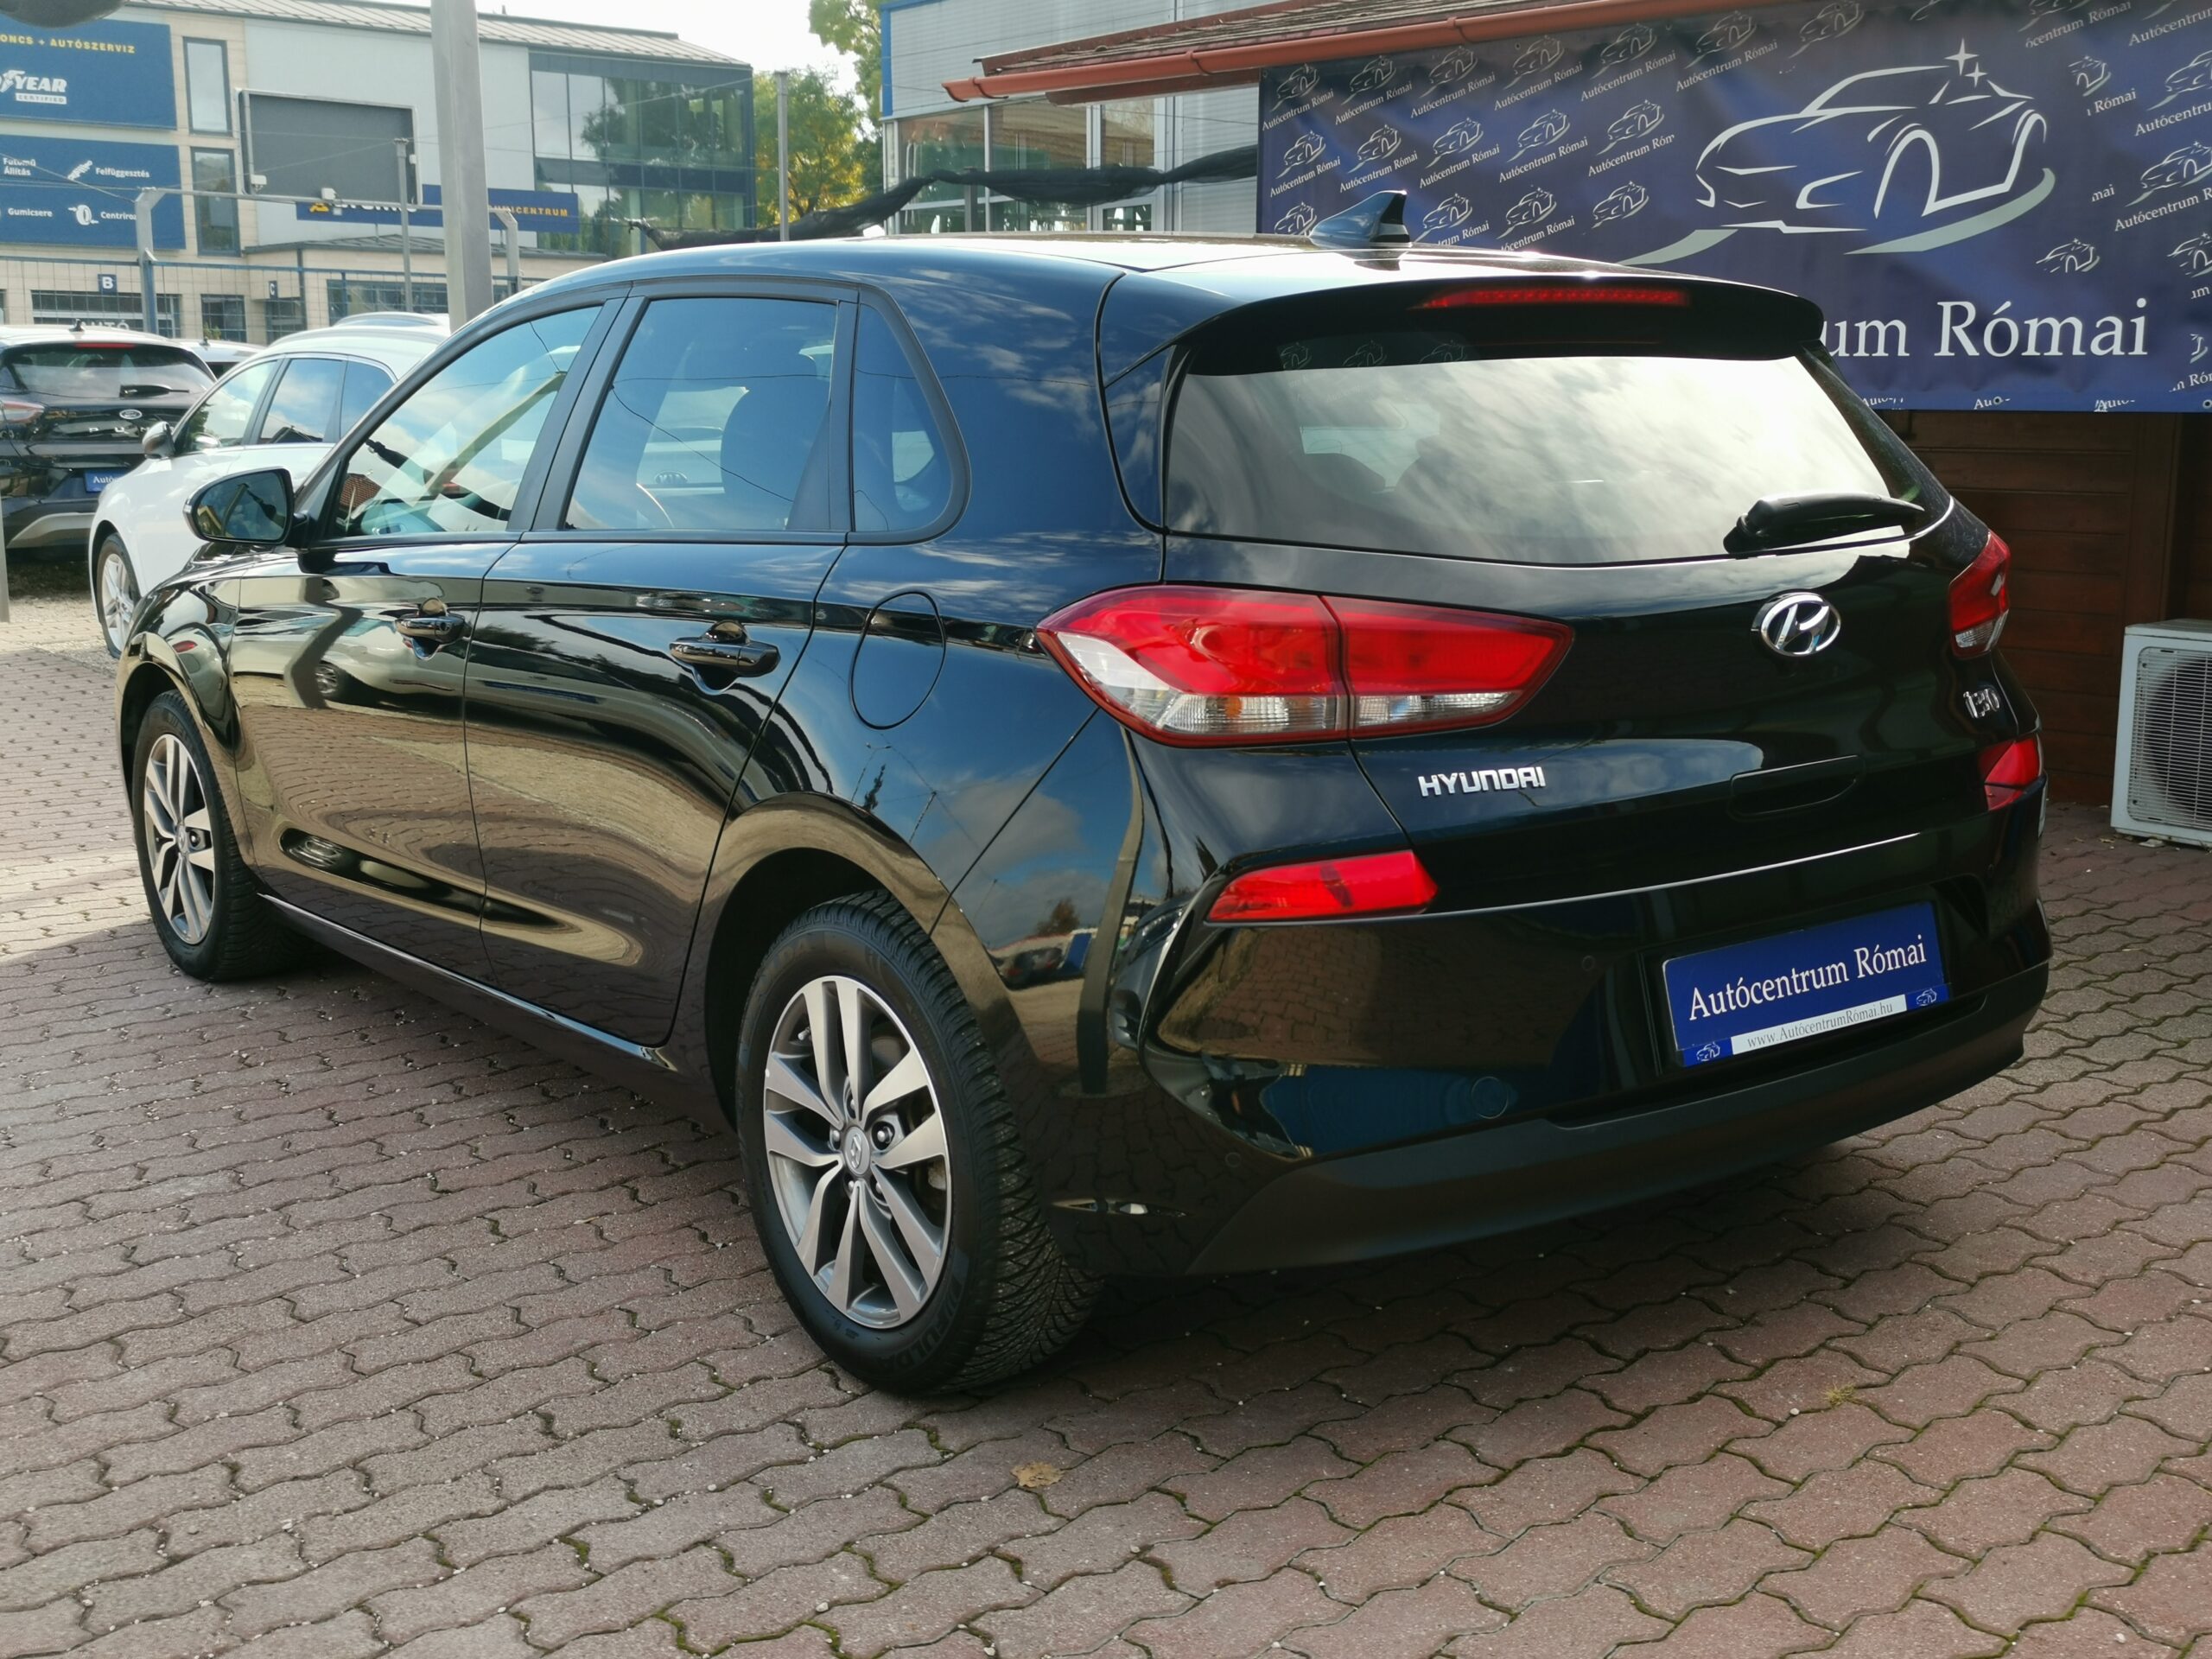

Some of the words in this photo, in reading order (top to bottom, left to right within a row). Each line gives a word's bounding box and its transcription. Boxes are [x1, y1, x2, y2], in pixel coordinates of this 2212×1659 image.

[2088, 1, 2132, 24] Római
[50, 38, 136, 54] AUTÓSZERVIZ
[1675, 57, 1742, 92] Autócentrum
[1745, 40, 1778, 62] Római
[1410, 86, 1466, 118] Autócentrum
[1468, 72, 1496, 92] Római
[1494, 79, 1553, 111] Autócentrum
[1554, 61, 1583, 82] Római
[1580, 68, 1643, 101] Autócentrum
[1645, 50, 1676, 72] Római
[1262, 103, 1311, 130] Autócentrum
[1312, 91, 1334, 109] Római
[1335, 95, 1383, 125] Autócentrum
[1387, 81, 1413, 99] Római
[2094, 88, 2137, 114] Római
[1270, 169, 1315, 198] Autócentrum
[1316, 156, 1341, 175] Római
[1339, 166, 1393, 194] Autócentrum
[1394, 150, 1419, 169] Római
[1419, 159, 1471, 188] Autócentrum
[1471, 144, 1501, 163] Római
[1499, 152, 1556, 183] Autócentrum
[1558, 137, 1589, 156] Római
[1588, 145, 1650, 176] Autócentrum
[8, 207, 53, 218] Gumicsere
[1462, 220, 1491, 239] Római
[1547, 216, 1575, 235] Római
[2114, 195, 2199, 232] Autócentrum
[102, 276, 113, 289] B
[1934, 297, 2148, 357] Római
[1418, 766, 1547, 797] HYUNDAI
[1689, 959, 1849, 1021] Autócentrum
[1853, 934, 1927, 979] Római
[1746, 1003, 1894, 1049] www.AutócentrumRómai.hu
